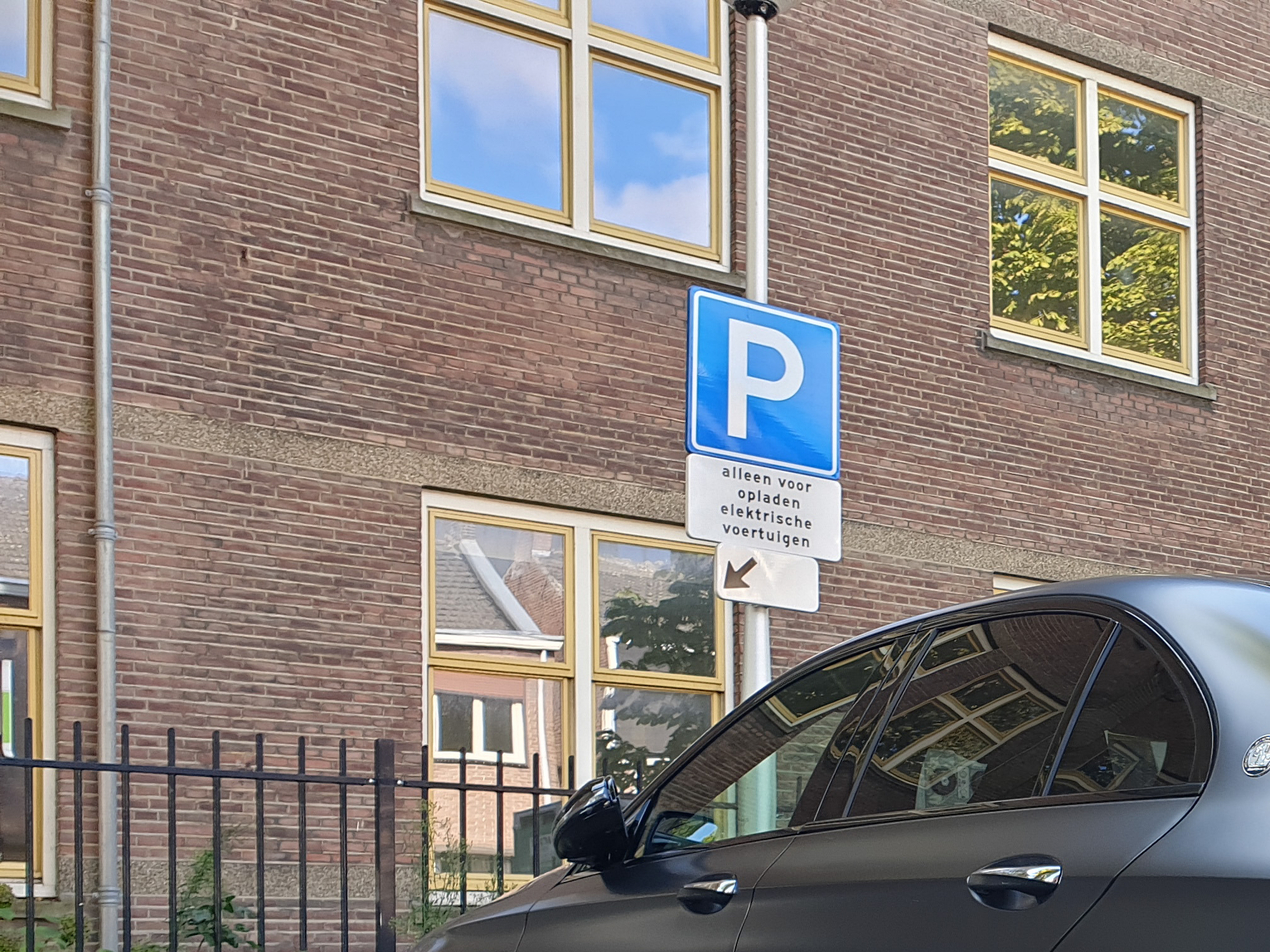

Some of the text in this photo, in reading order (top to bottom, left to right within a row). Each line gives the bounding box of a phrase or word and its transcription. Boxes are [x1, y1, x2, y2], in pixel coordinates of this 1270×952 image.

[727, 318, 804, 439] P
[722, 467, 812, 493] alleen voor
[737, 488, 800, 510] opladen
[720, 504, 812, 530] elektrische
[722, 523, 810, 548] voertuigen
